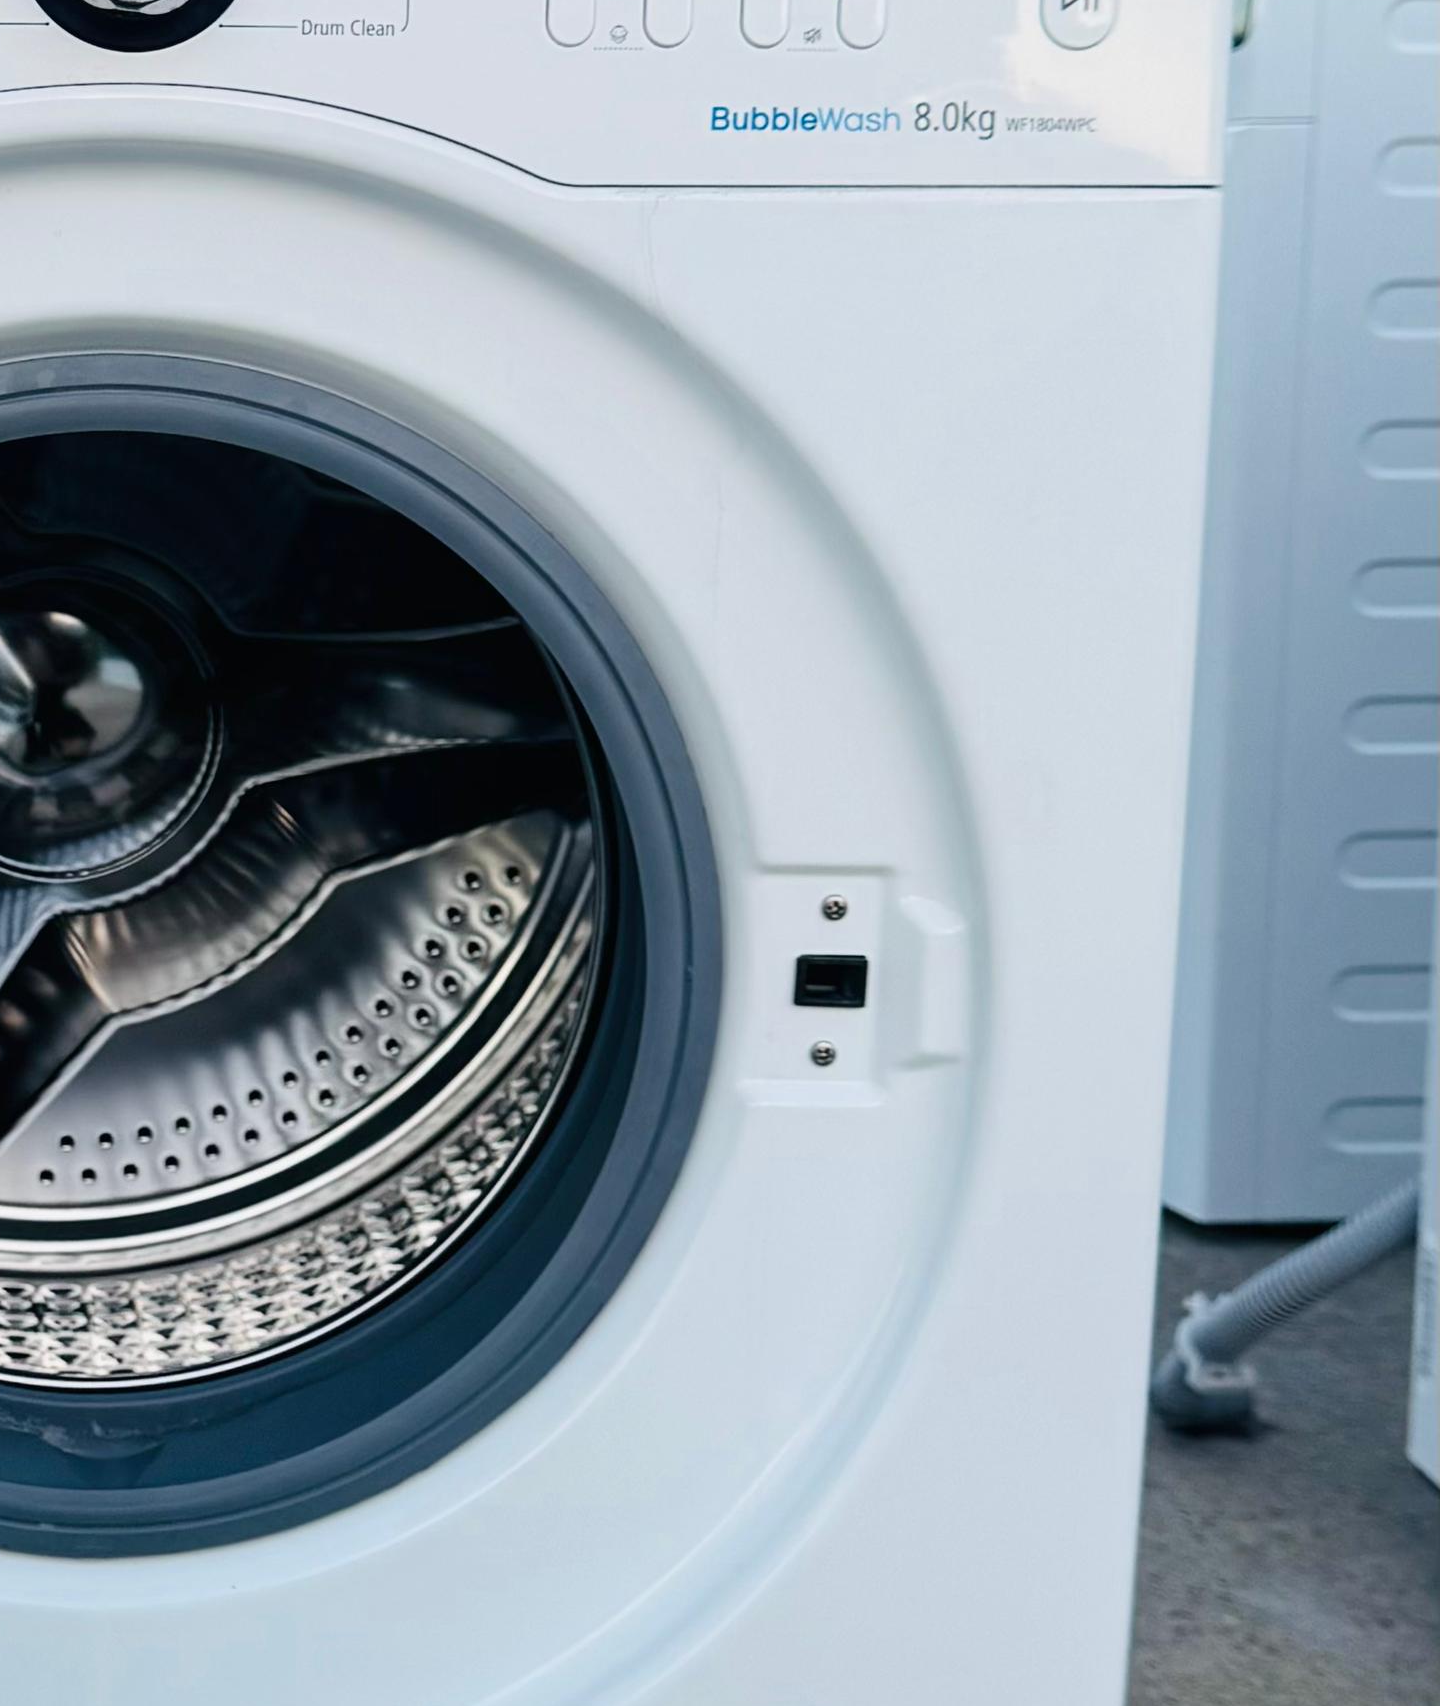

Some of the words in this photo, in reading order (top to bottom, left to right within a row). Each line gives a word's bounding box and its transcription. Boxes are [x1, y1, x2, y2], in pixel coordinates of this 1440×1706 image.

[301, 19, 346, 37] Drum
[349, 19, 396, 38] Clean
[711, 105, 901, 133] BubbleWash
[913, 101, 996, 140] 8.0kg
